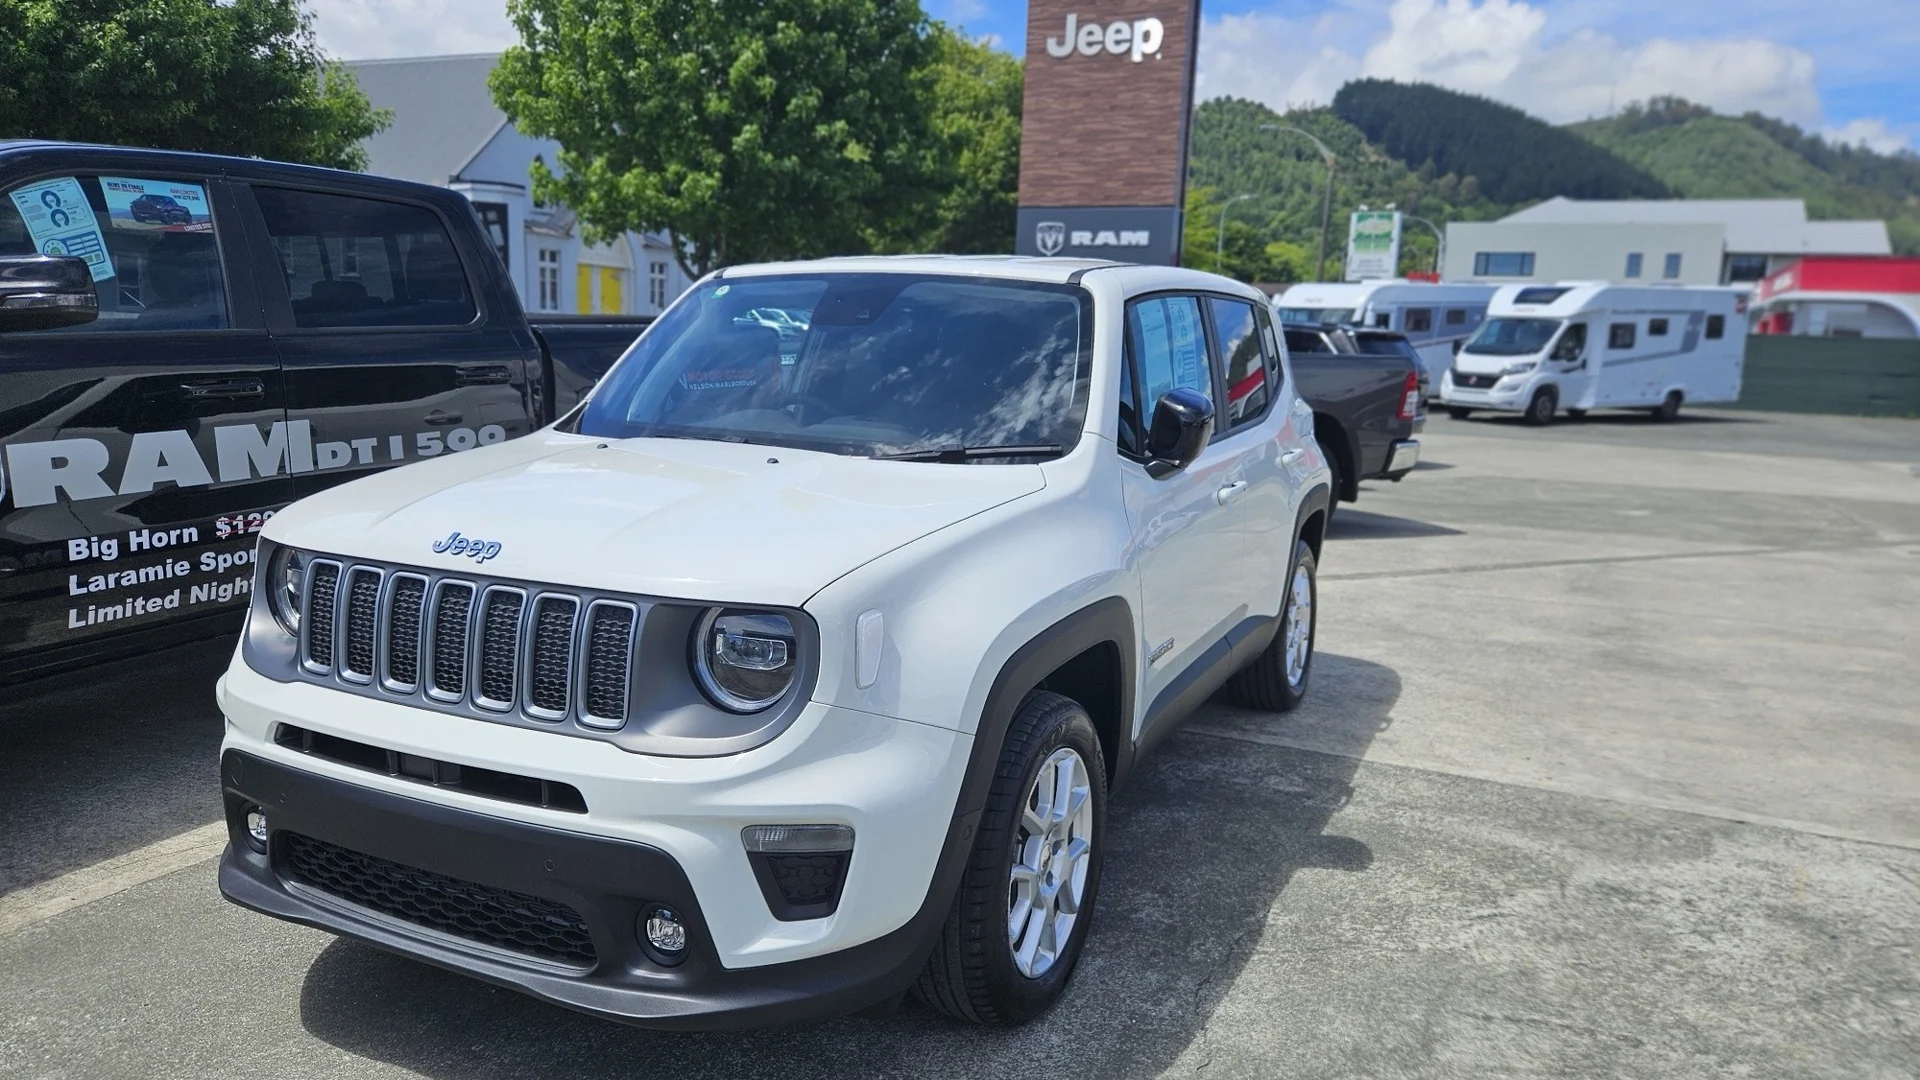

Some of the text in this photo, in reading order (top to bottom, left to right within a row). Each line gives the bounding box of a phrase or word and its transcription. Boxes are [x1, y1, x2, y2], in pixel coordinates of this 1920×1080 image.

[1046, 13, 1164, 62] Jeep
[1071, 231, 1149, 246] RAM
[6, 419, 314, 509] RAM
[316, 437, 378, 470] DT
[68, 536, 118, 561] Big
[129, 525, 199, 551] Horn
[432, 531, 502, 563] Jeep
[68, 558, 191, 596] Laramie
[68, 589, 181, 629] Limited
